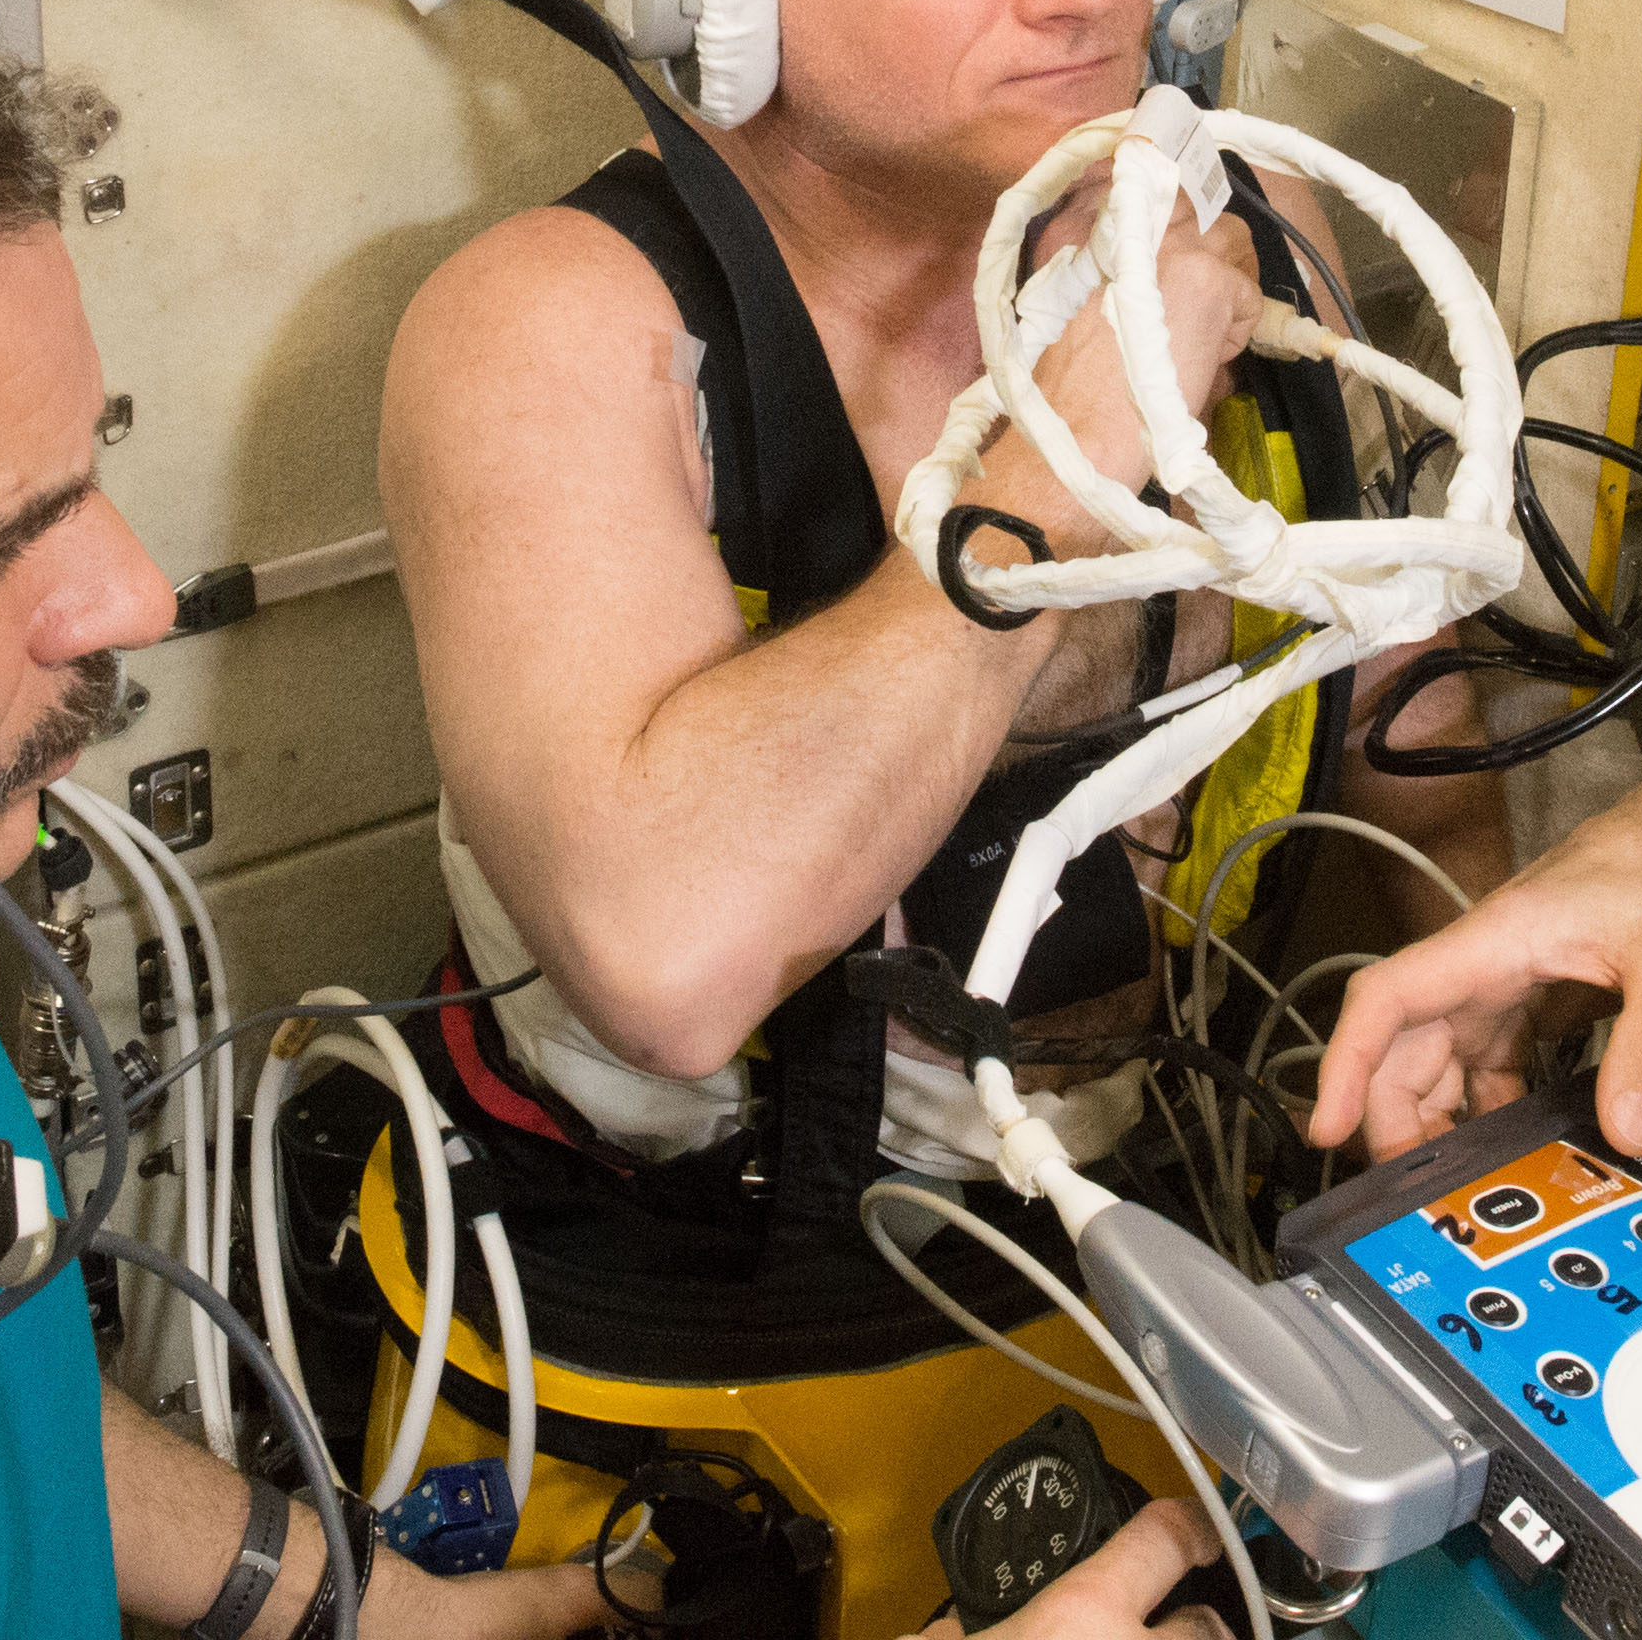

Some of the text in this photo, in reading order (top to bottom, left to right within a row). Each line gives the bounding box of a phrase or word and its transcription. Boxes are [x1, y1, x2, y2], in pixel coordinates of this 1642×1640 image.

[1569, 1178, 1625, 1206] Brown
[1490, 1198, 1523, 1217] Freeze
[1387, 1269, 1431, 1295] DATA
[1482, 1297, 1507, 1314] Print
[1043, 1474, 1060, 1497] 30
[1058, 1486, 1075, 1509] 40
[1049, 1533, 1067, 1555] 60
